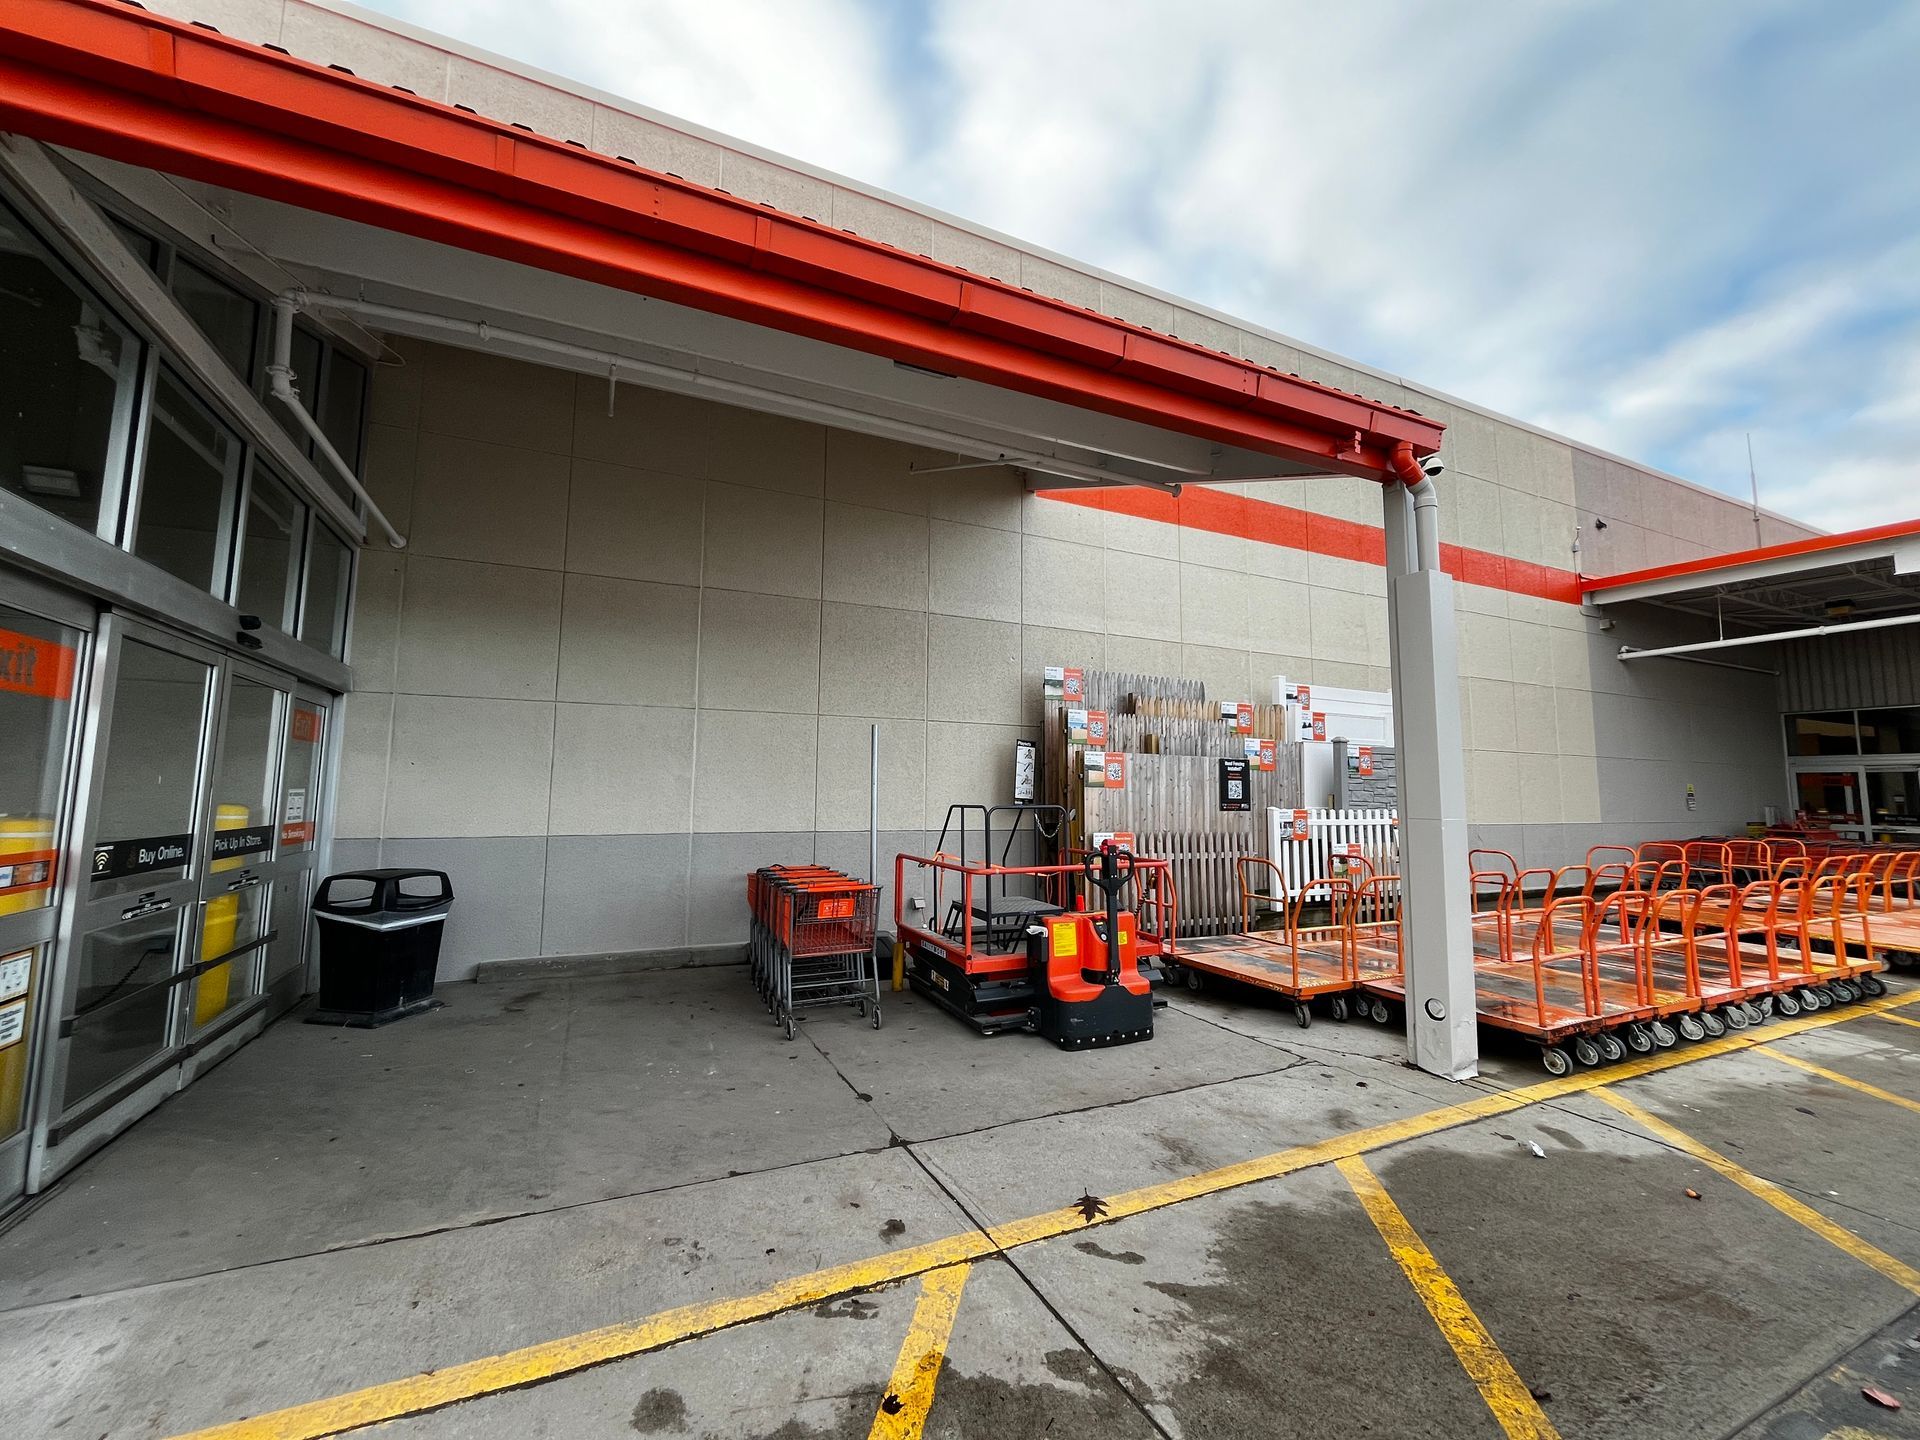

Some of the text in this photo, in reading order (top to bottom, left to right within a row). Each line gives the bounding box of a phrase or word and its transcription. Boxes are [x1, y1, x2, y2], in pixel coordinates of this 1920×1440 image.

[214, 835, 263, 851] Pick Up In Store.
[138, 845, 185, 865] Buy Online.
